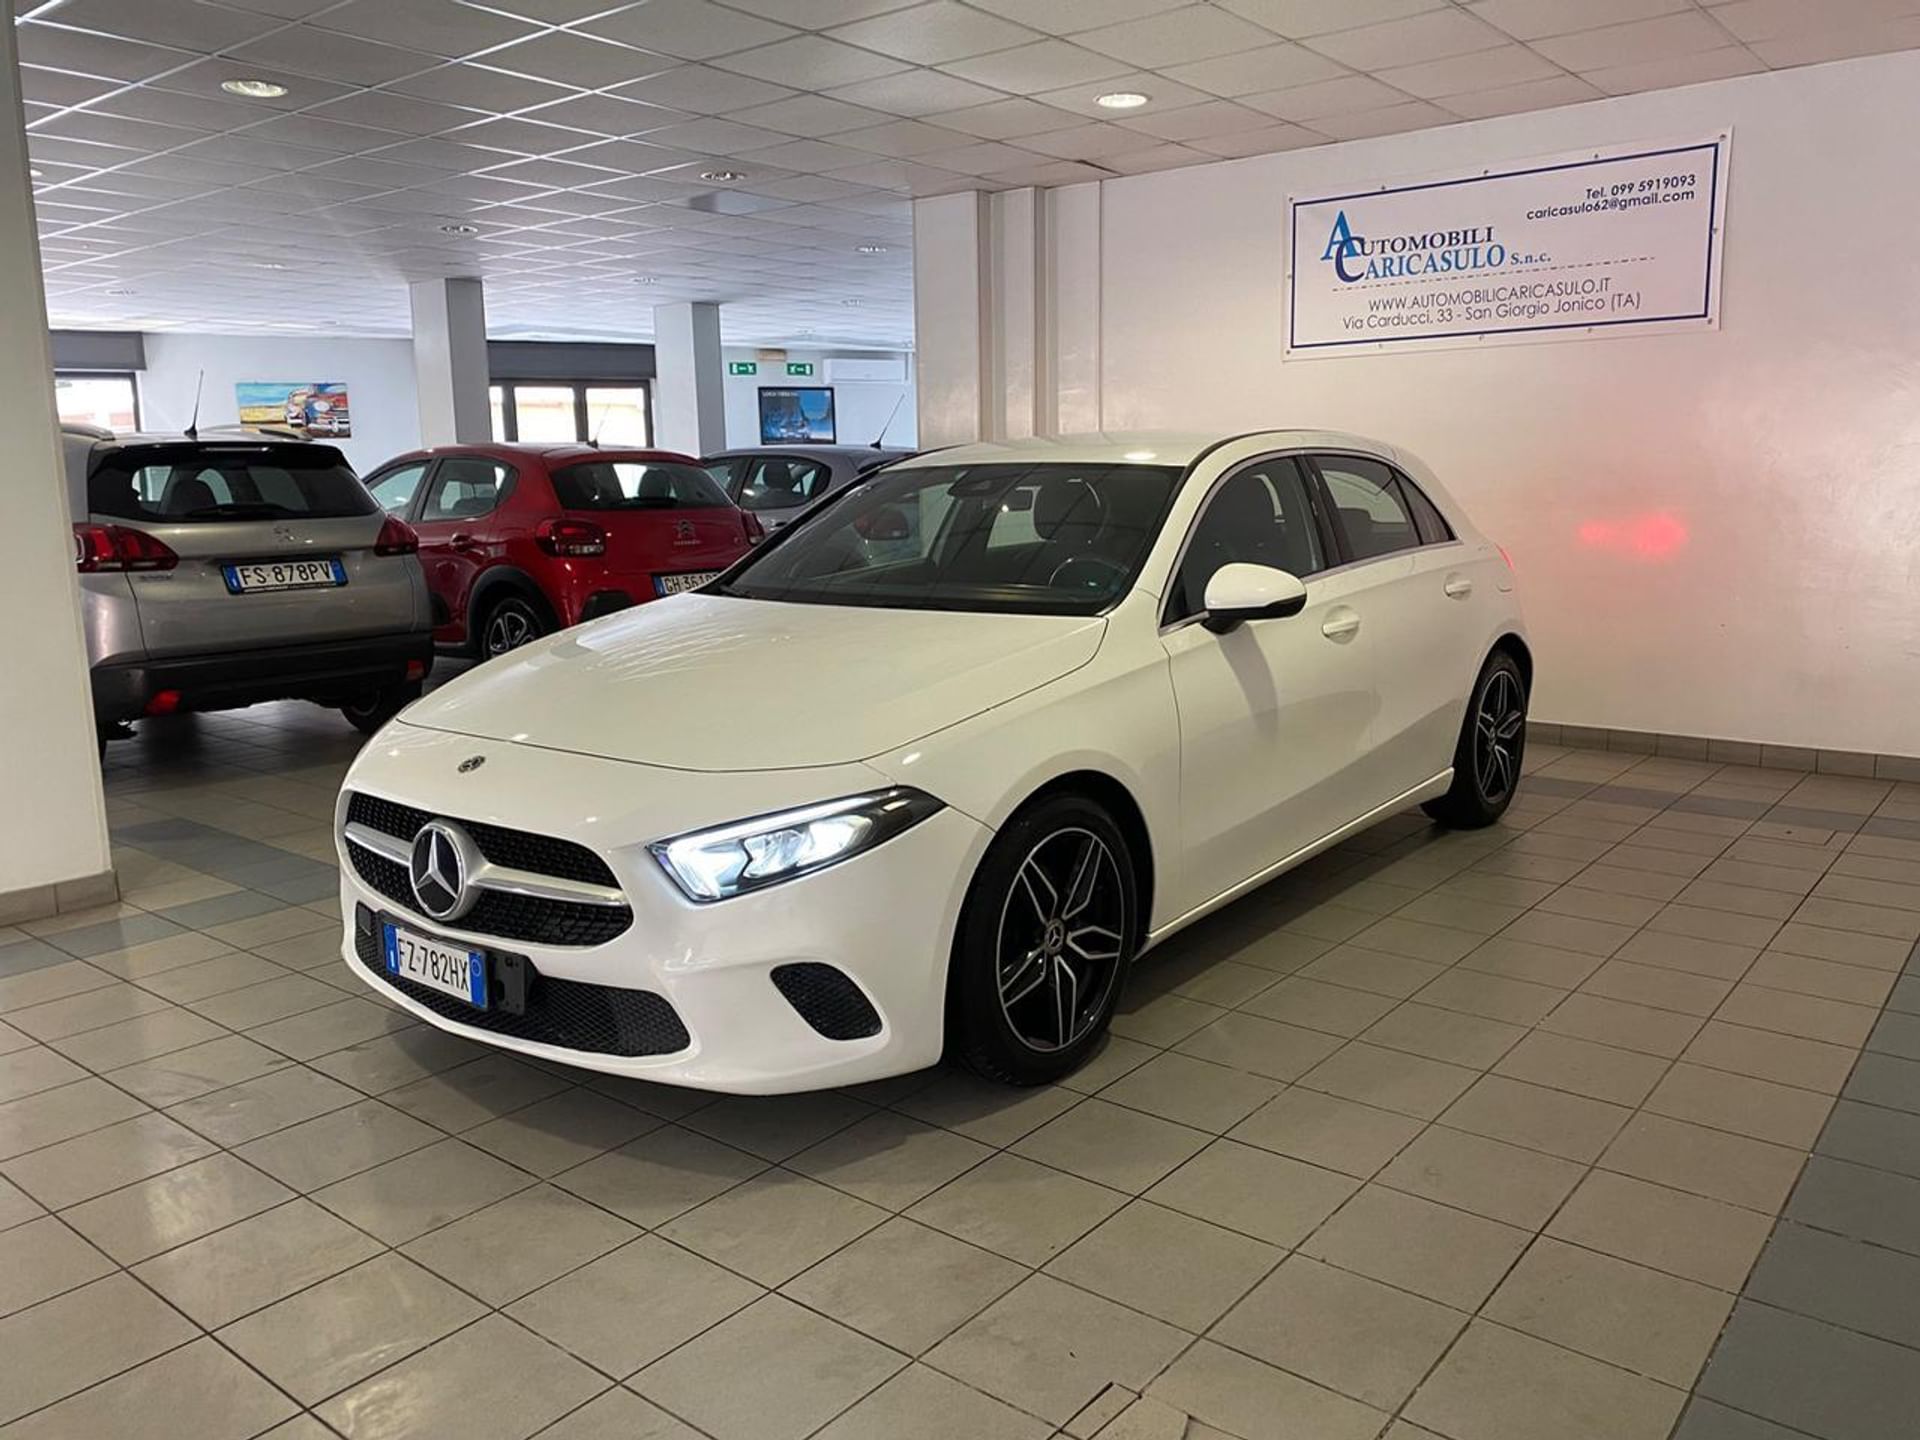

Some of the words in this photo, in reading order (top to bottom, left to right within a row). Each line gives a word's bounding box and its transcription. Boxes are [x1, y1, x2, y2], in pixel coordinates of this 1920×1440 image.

[1526, 189, 1695, 220] caricasulo62@gmail.com
[1586, 187, 1606, 200] Tel.
[1611, 183, 1634, 196] 099
[1638, 174, 1696, 192] 5919093
[1335, 236, 1505, 283] CARICASULO
[1343, 314, 1363, 330] Via
[1437, 308, 1453, 322] 33
[1465, 305, 1492, 321] San
[1496, 299, 1550, 318] Giorgio
[1553, 295, 1606, 314] Jonico
[1610, 292, 1641, 312] (TA)
[1368, 277, 1611, 312] WWW.AUTOMOBILICARICASULO.IT
